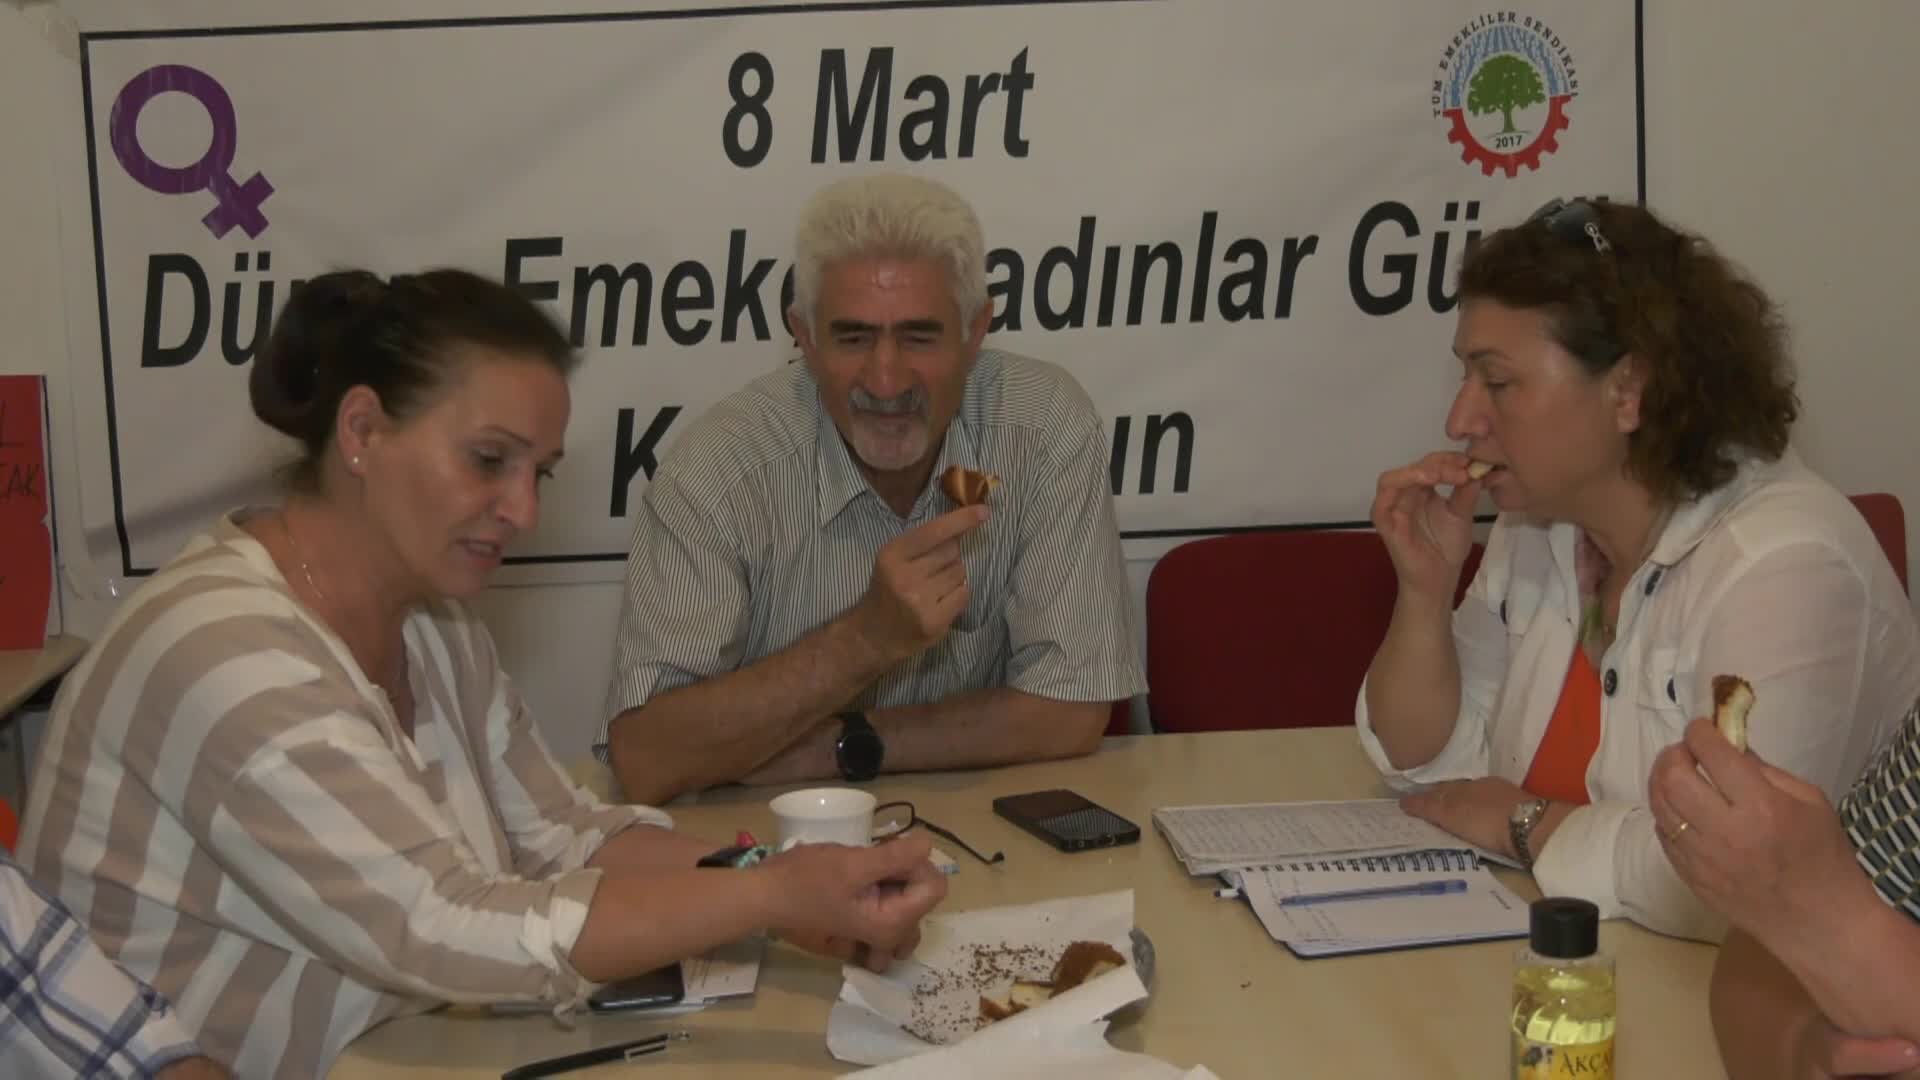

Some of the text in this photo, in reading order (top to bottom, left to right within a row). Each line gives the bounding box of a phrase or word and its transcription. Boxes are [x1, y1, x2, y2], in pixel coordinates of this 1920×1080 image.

[1439, 11, 1517, 71] EMEKLİLER
[1523, 16, 1580, 98] SENDİKASI
[722, 46, 1035, 169] 8 Mart
[1495, 135, 1523, 149] 2017
[503, 228, 799, 348] Emek
[985, 210, 1319, 334] adınlar
